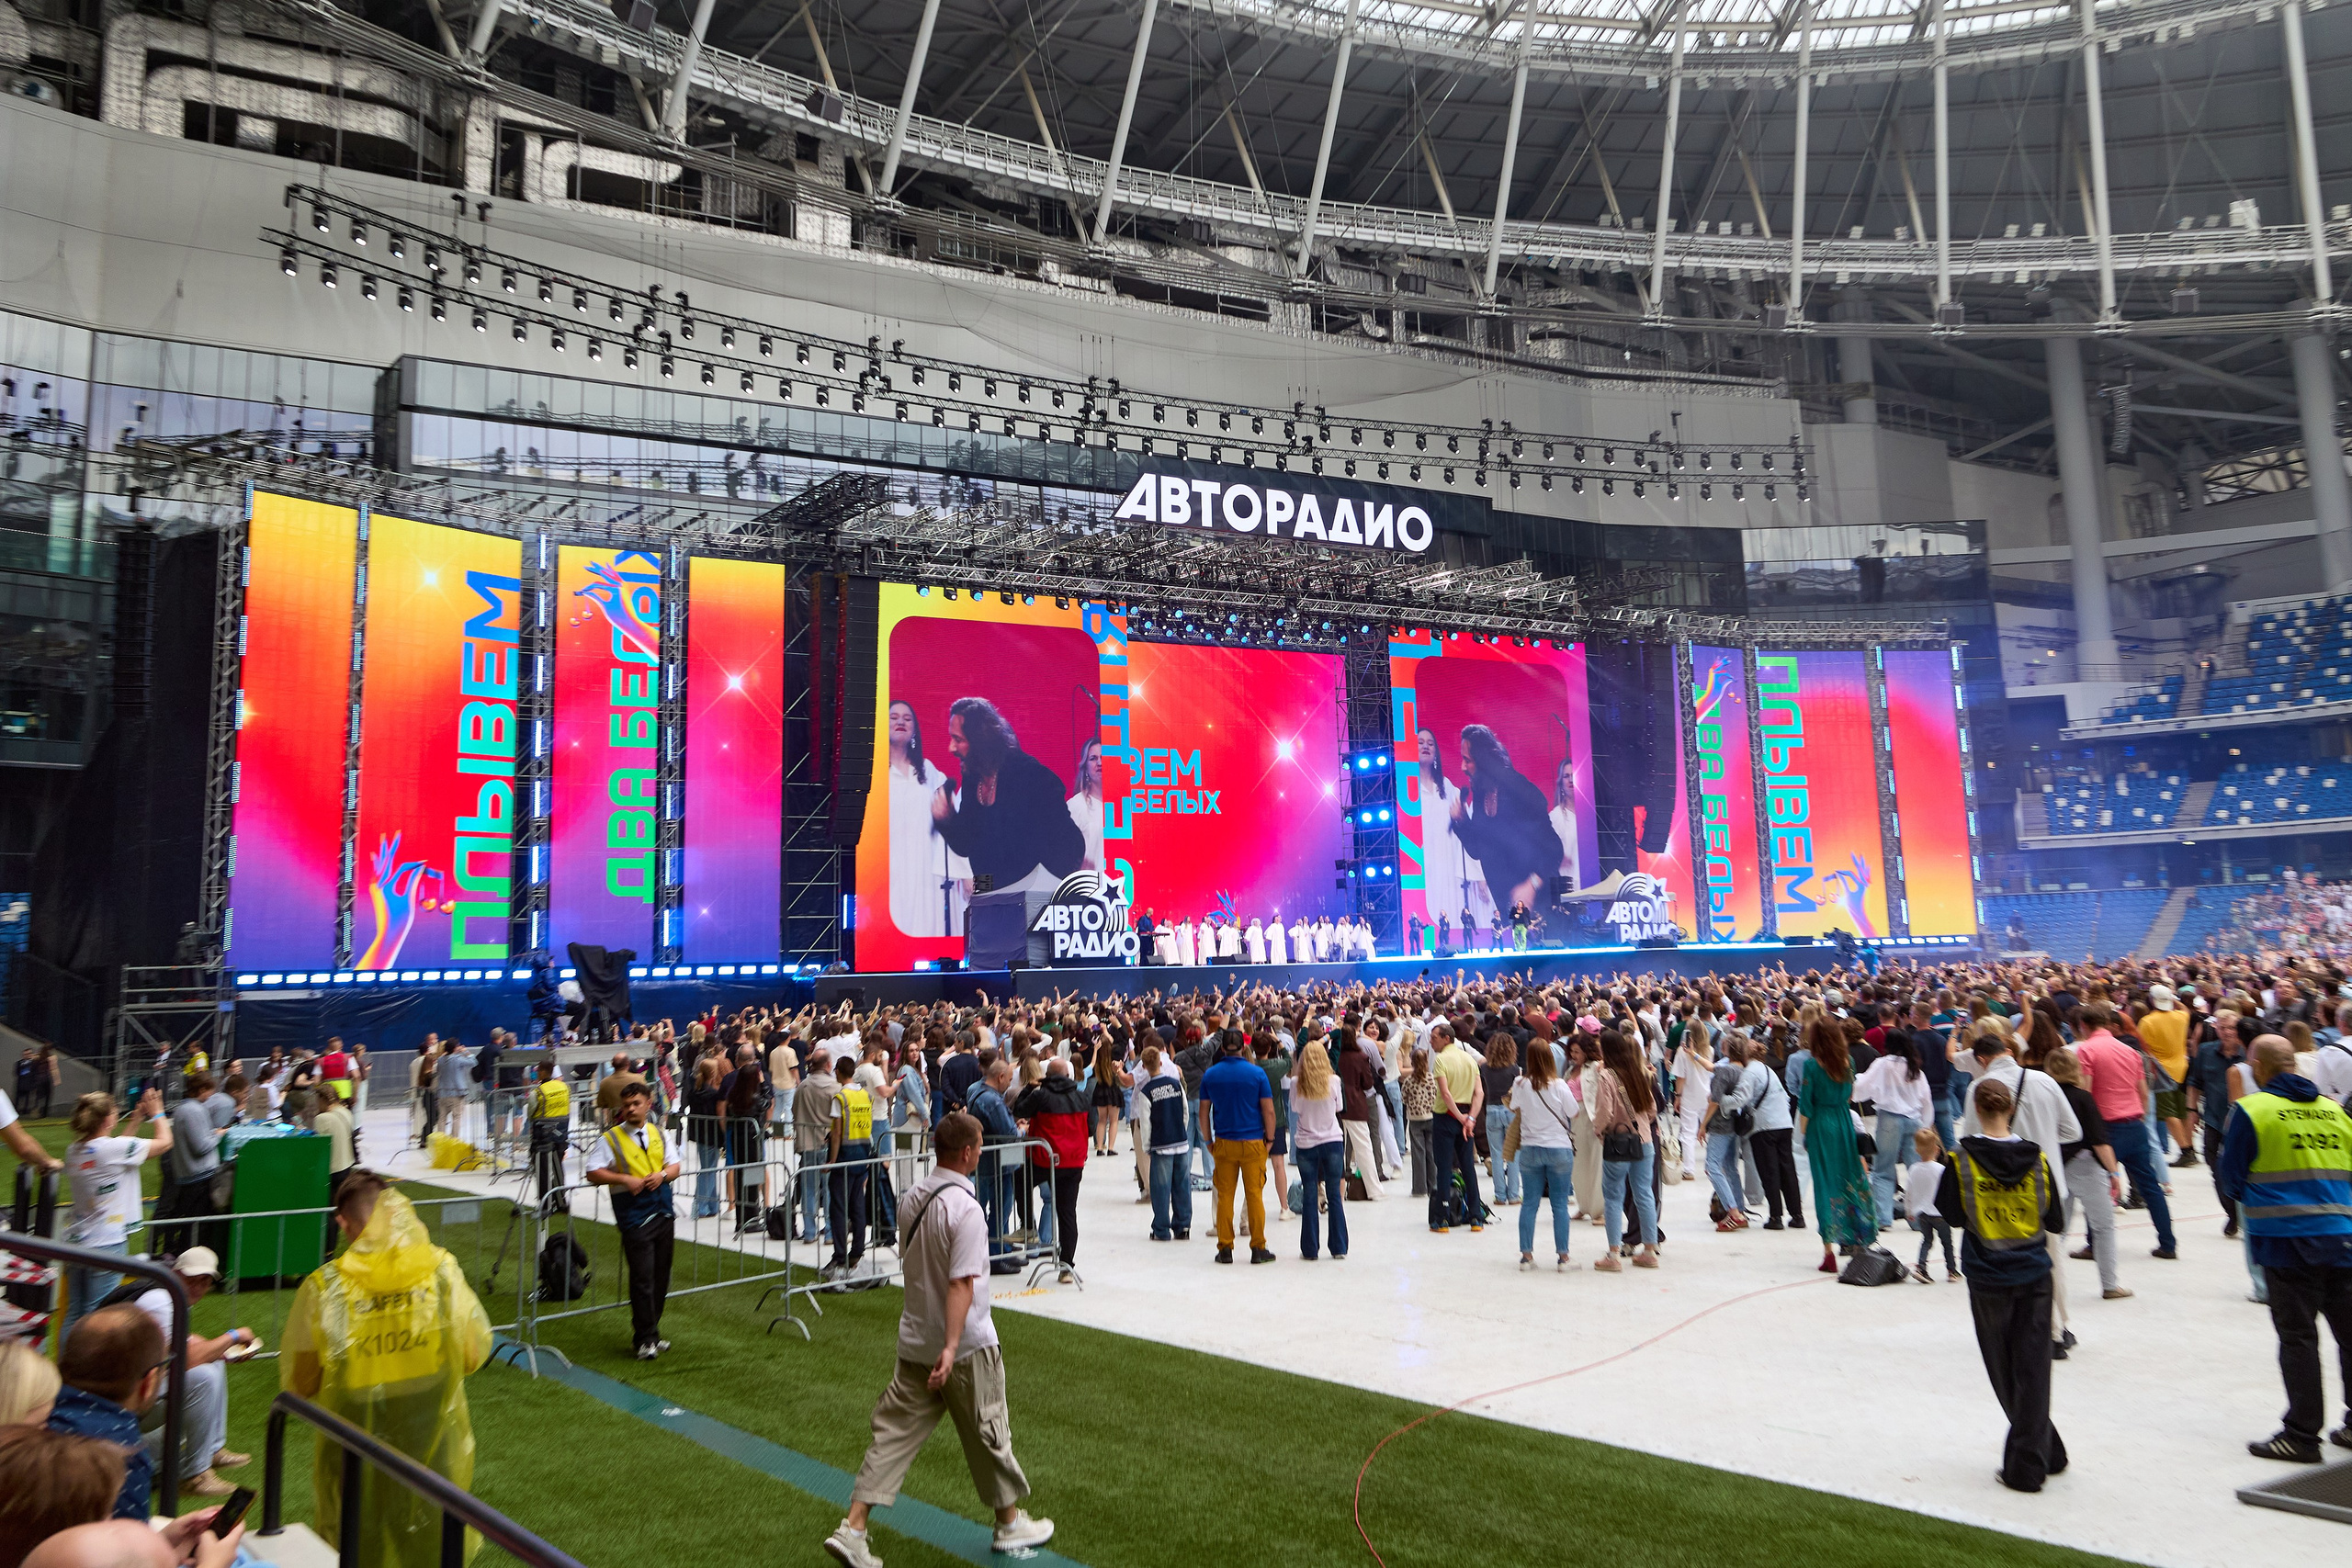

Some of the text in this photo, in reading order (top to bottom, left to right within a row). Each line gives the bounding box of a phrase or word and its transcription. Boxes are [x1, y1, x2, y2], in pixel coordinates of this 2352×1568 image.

[1114, 472, 1434, 552] АВТОРАДИО
[450, 570, 521, 961] ПЛЫВЕМ
[1757, 656, 1817, 913] ПЛЫВЕМ
[1131, 788, 1222, 815] БЕЛЫХ
[606, 768, 658, 905] ДВА
[1032, 904, 1104, 931] АВТО
[1604, 900, 1655, 924] АВТО
[1054, 931, 1140, 958] РАДИО
[2277, 1108, 2336, 1121] STEWARD
[2289, 1132, 2339, 1150] 2092
